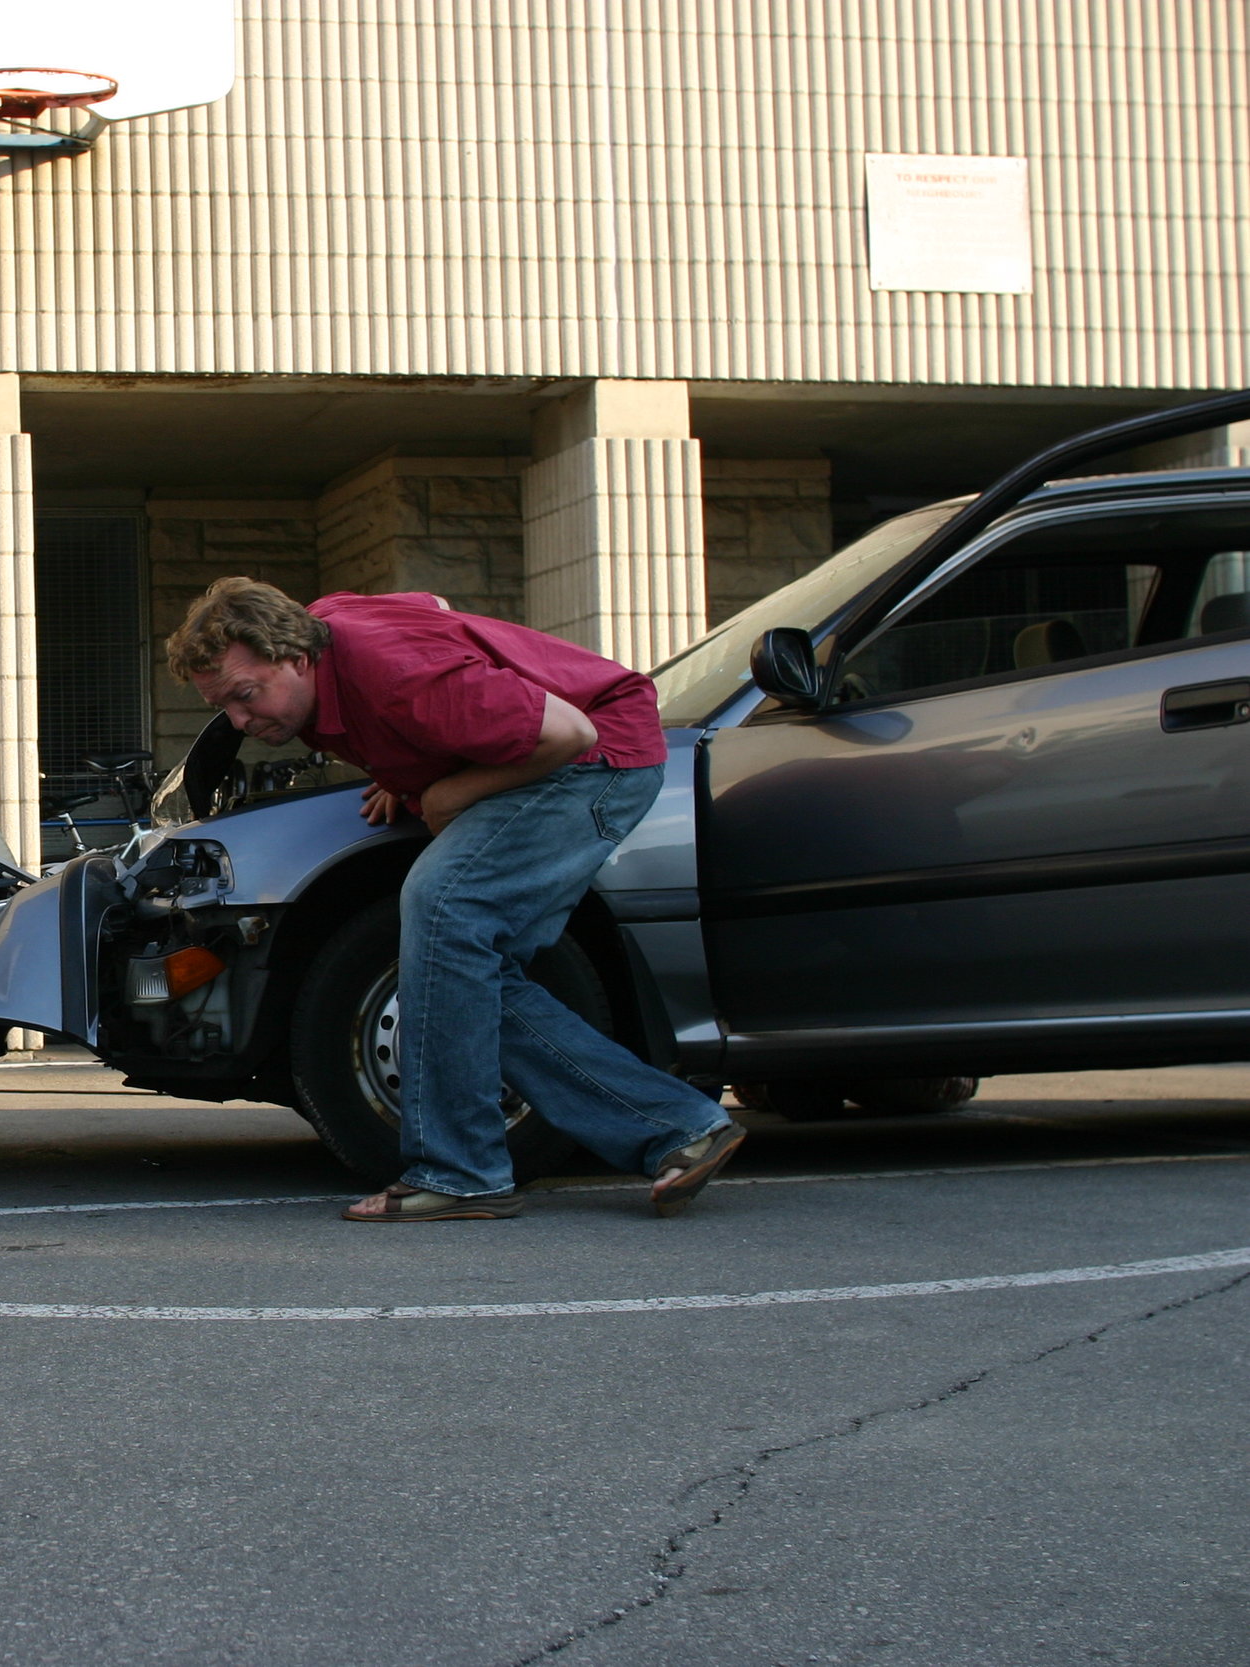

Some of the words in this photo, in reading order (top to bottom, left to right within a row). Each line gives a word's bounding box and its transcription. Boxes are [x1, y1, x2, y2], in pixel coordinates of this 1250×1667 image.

[896, 173, 913, 183] TO
[915, 174, 969, 184] RESPECT
[972, 176, 998, 185] OUR
